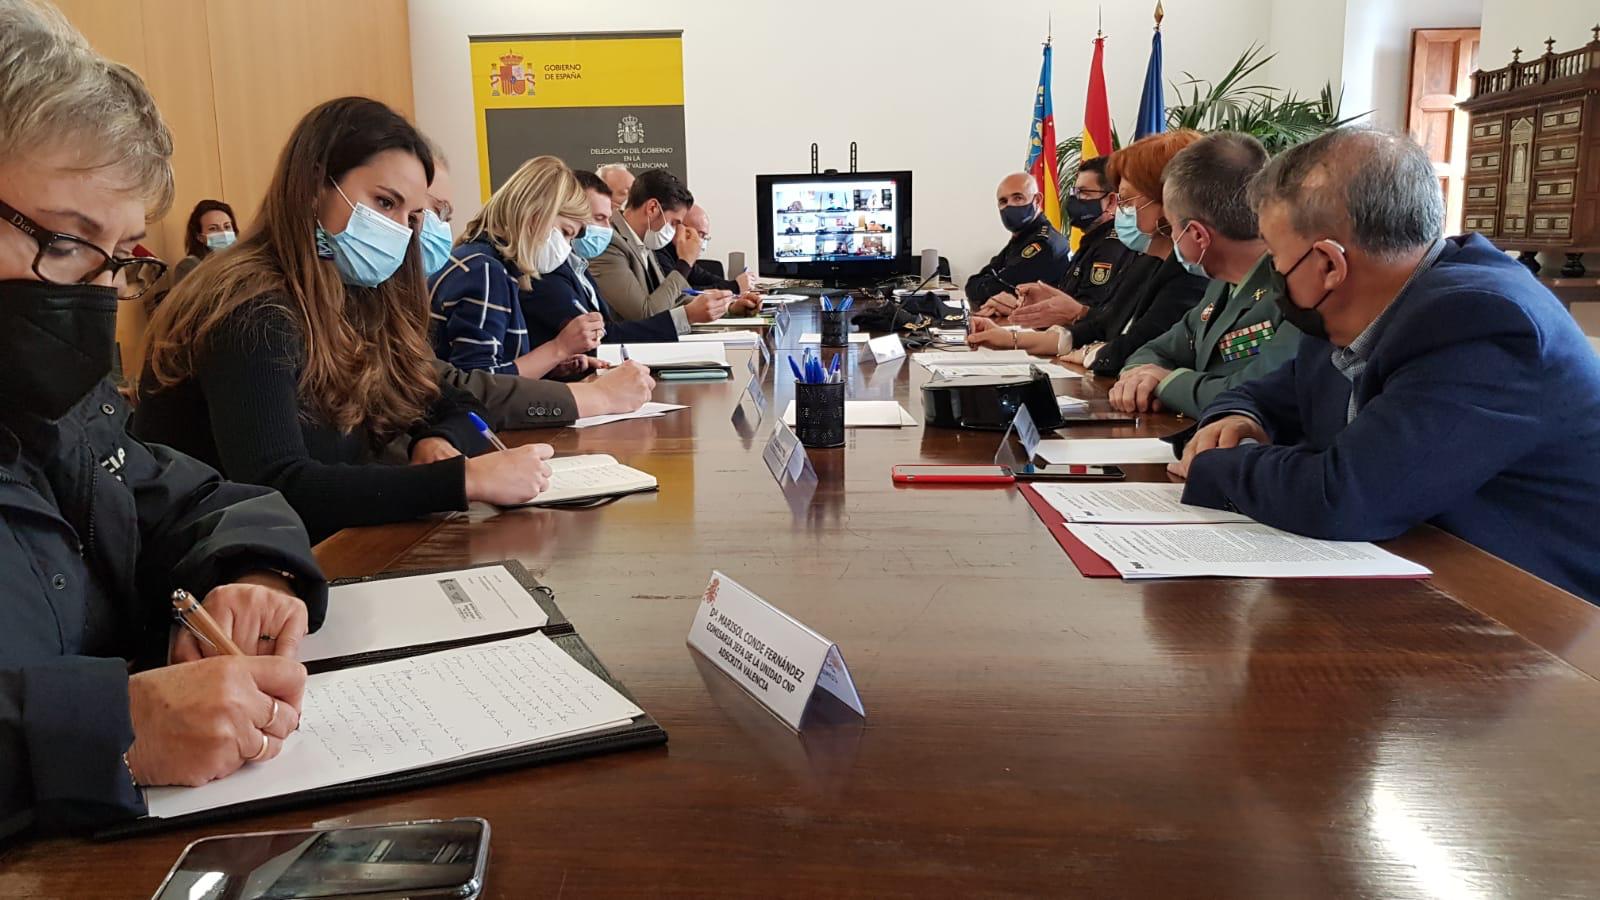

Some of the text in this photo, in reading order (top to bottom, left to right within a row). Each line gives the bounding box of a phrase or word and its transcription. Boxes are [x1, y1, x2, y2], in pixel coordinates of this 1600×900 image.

[556, 72, 582, 80] ESPAÑA
[590, 147, 628, 155] DELEGACIÓN
[10, 213, 35, 234] Dior
[706, 622, 796, 694] COMISARIA JEFA DE LA UNIDAD CNP
[719, 613, 743, 639] MARISOL
[743, 632, 764, 654] CONDE
[764, 647, 805, 683] FERNÁNDEZ
[718, 647, 769, 692] ADSCRITA VALENCIA
